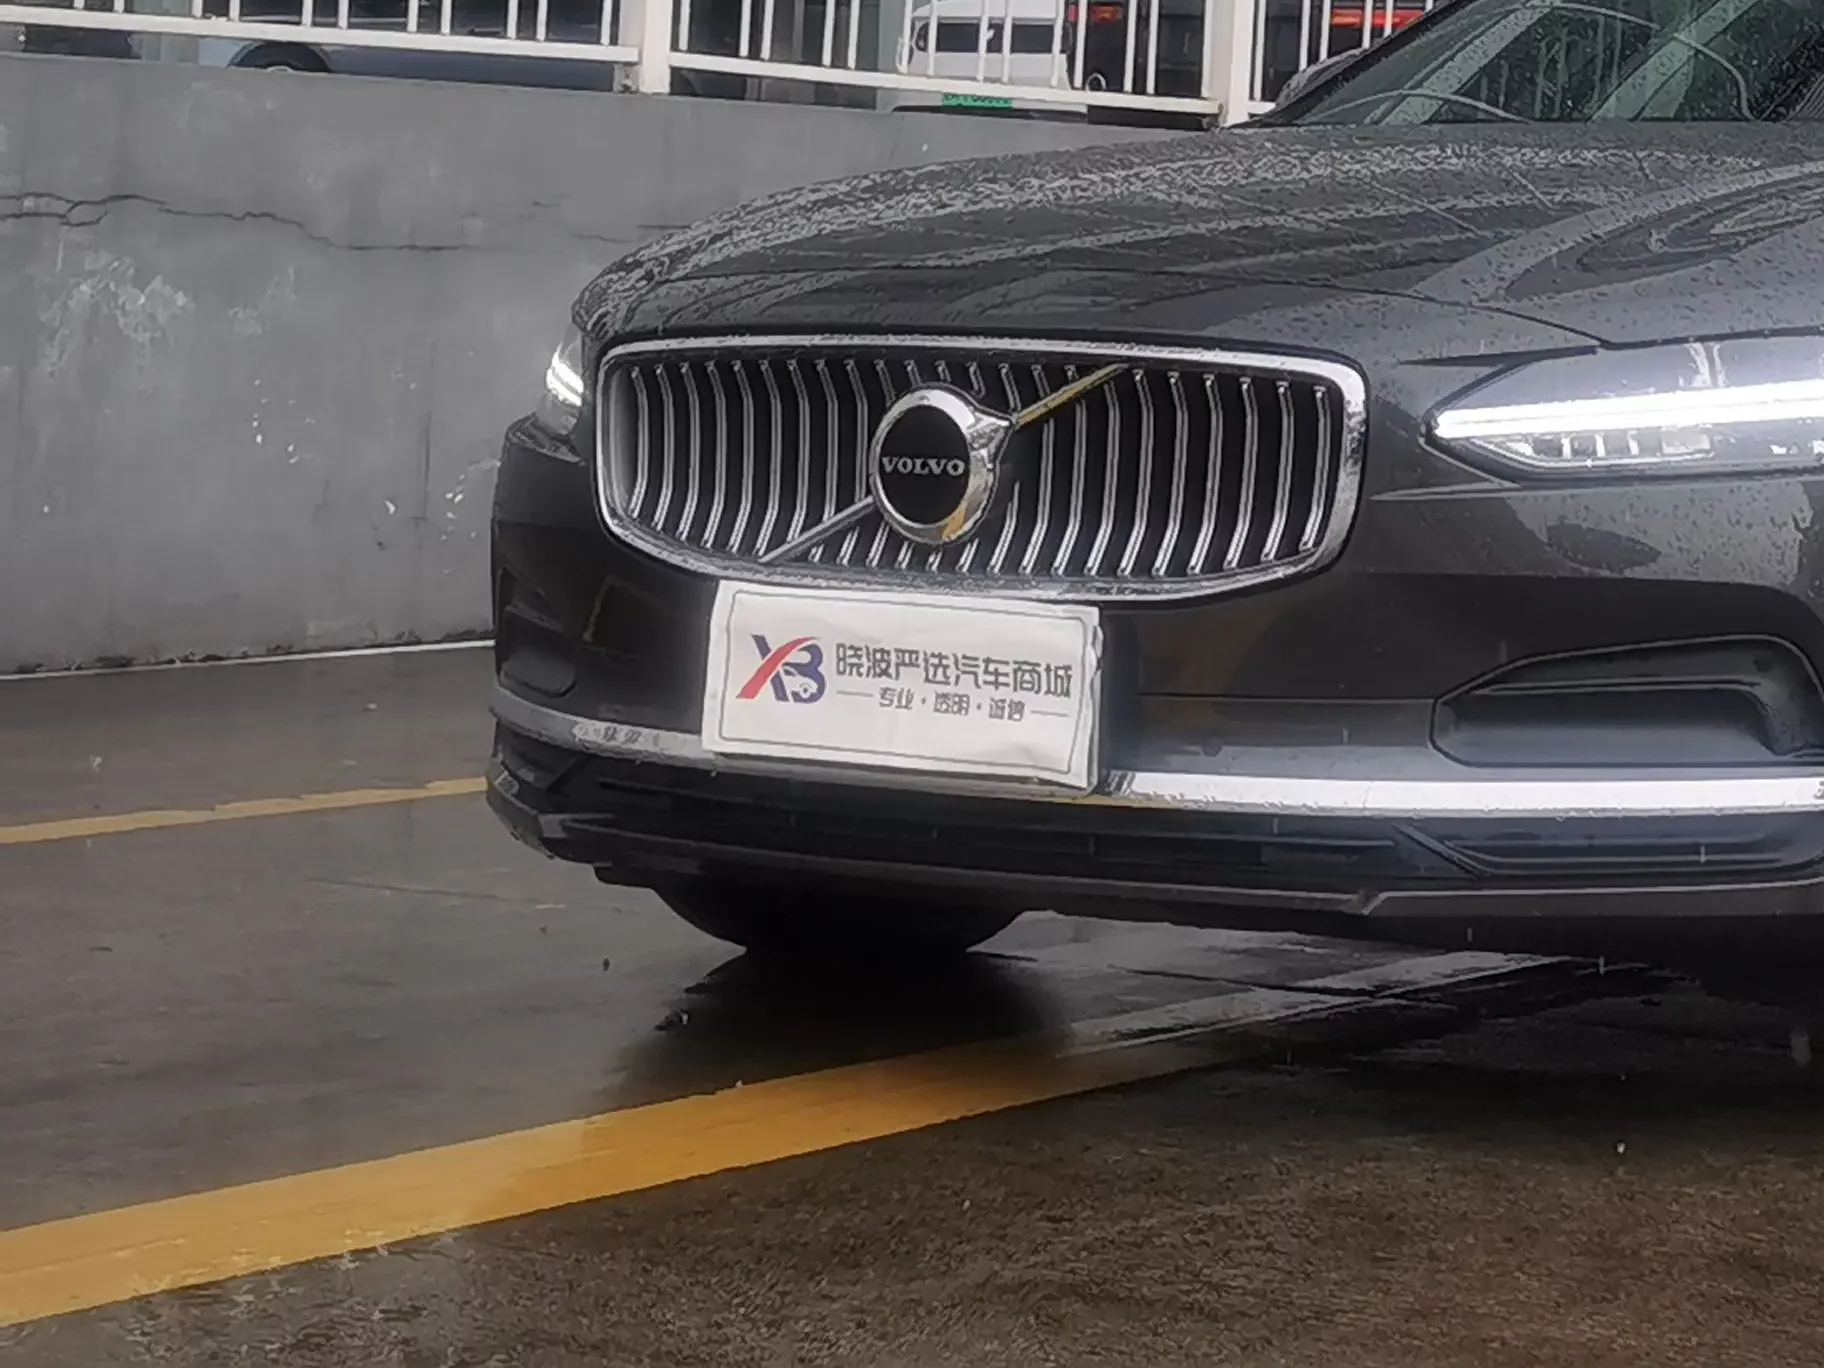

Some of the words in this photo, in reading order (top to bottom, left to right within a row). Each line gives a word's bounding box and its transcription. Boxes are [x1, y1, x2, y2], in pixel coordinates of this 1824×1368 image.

[881, 456, 966, 477] VOLVO
[834, 641, 1073, 699] 晓波严选汽车商城
